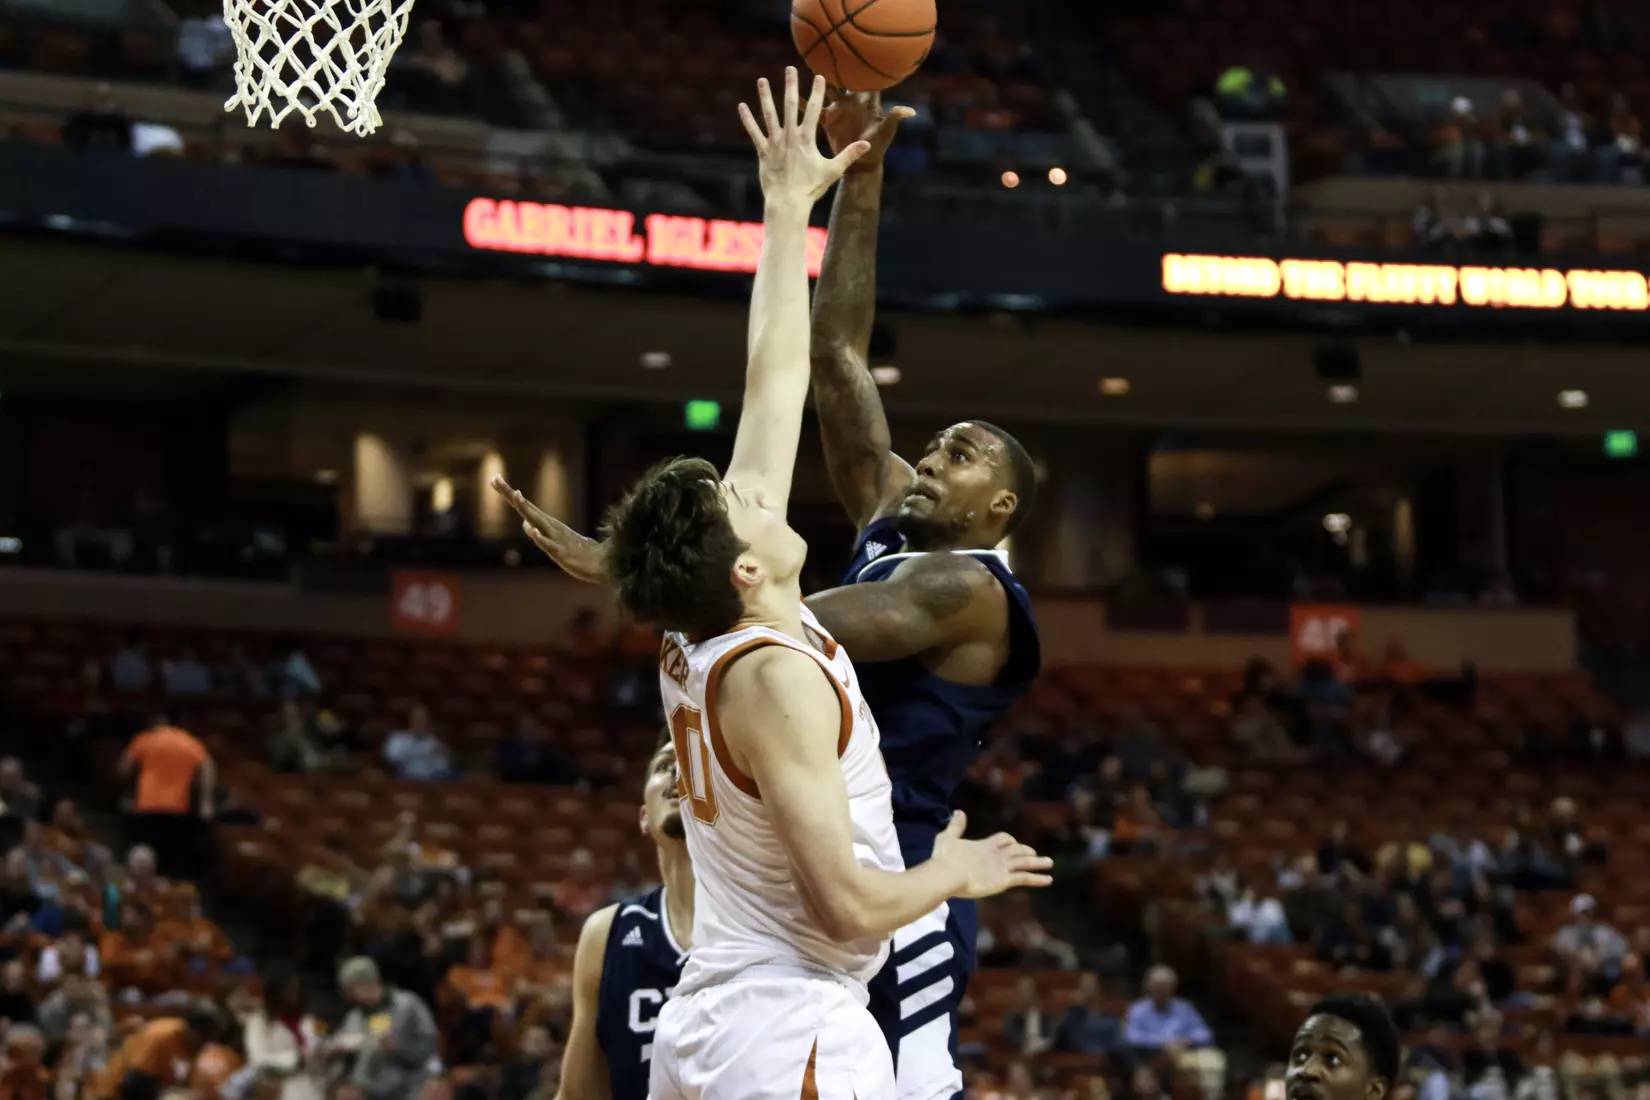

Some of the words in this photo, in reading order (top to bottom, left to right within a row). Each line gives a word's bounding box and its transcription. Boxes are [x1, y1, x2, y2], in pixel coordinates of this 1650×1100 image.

[464, 198, 645, 262] GABRIEL
[646, 214, 829, 277] IGLESS
[660, 638, 690, 692] KER
[671, 703, 720, 825] 0
